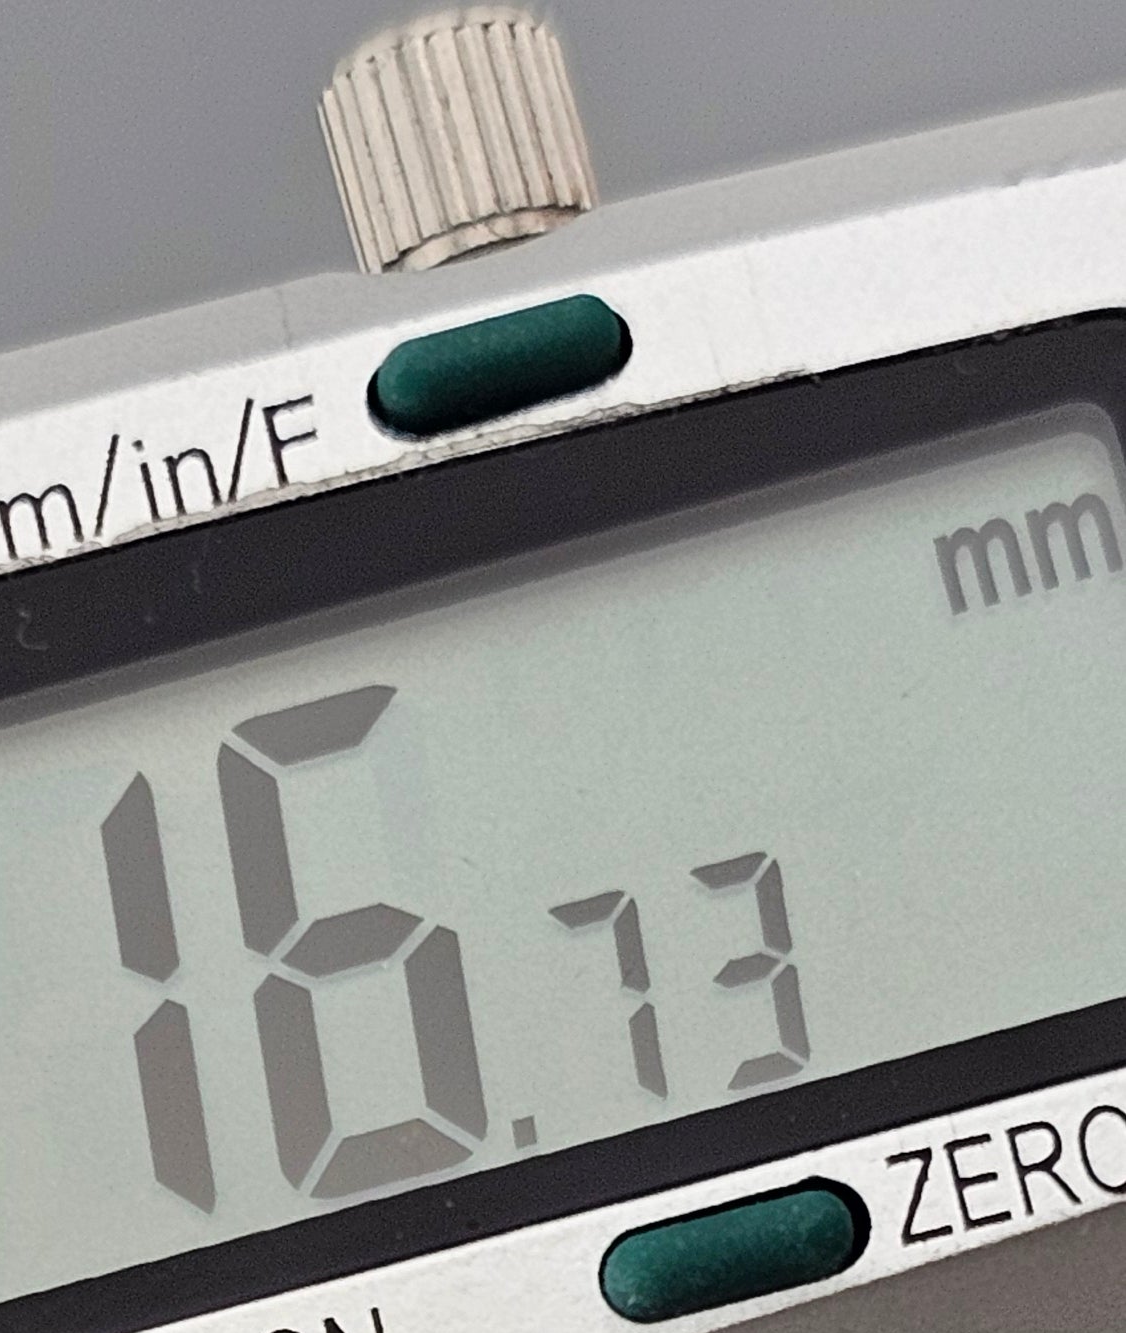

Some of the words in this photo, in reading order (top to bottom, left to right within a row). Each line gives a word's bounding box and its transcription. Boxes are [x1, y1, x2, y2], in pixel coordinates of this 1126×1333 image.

[933, 493, 1124, 616] mm
[100, 684, 812, 1214] 16.73
[884, 1105, 1126, 1246] ZERO
